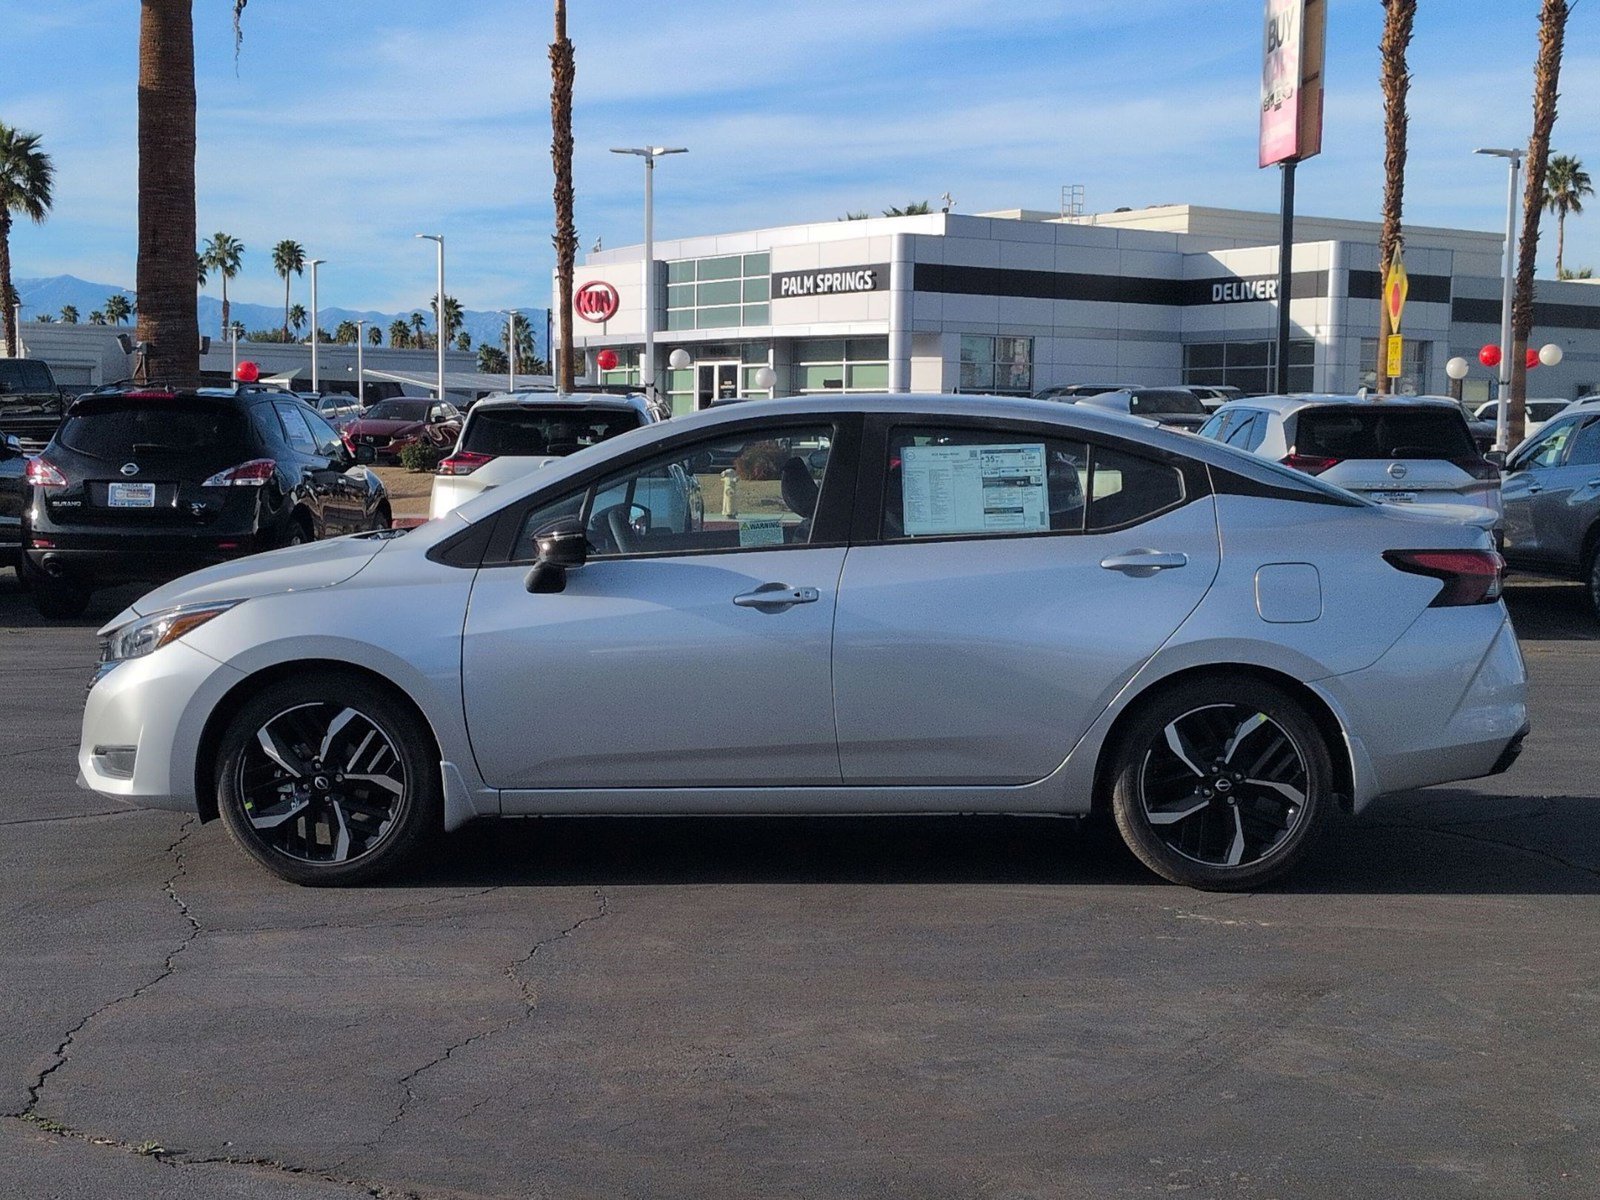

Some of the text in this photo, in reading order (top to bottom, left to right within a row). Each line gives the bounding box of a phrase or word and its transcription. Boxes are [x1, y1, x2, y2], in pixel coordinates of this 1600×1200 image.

[1267, 6, 1295, 54] BUY
[781, 269, 873, 296] PALM SPRINGS
[1212, 279, 1279, 302] DELIVER
[750, 520, 781, 530] WARNING
